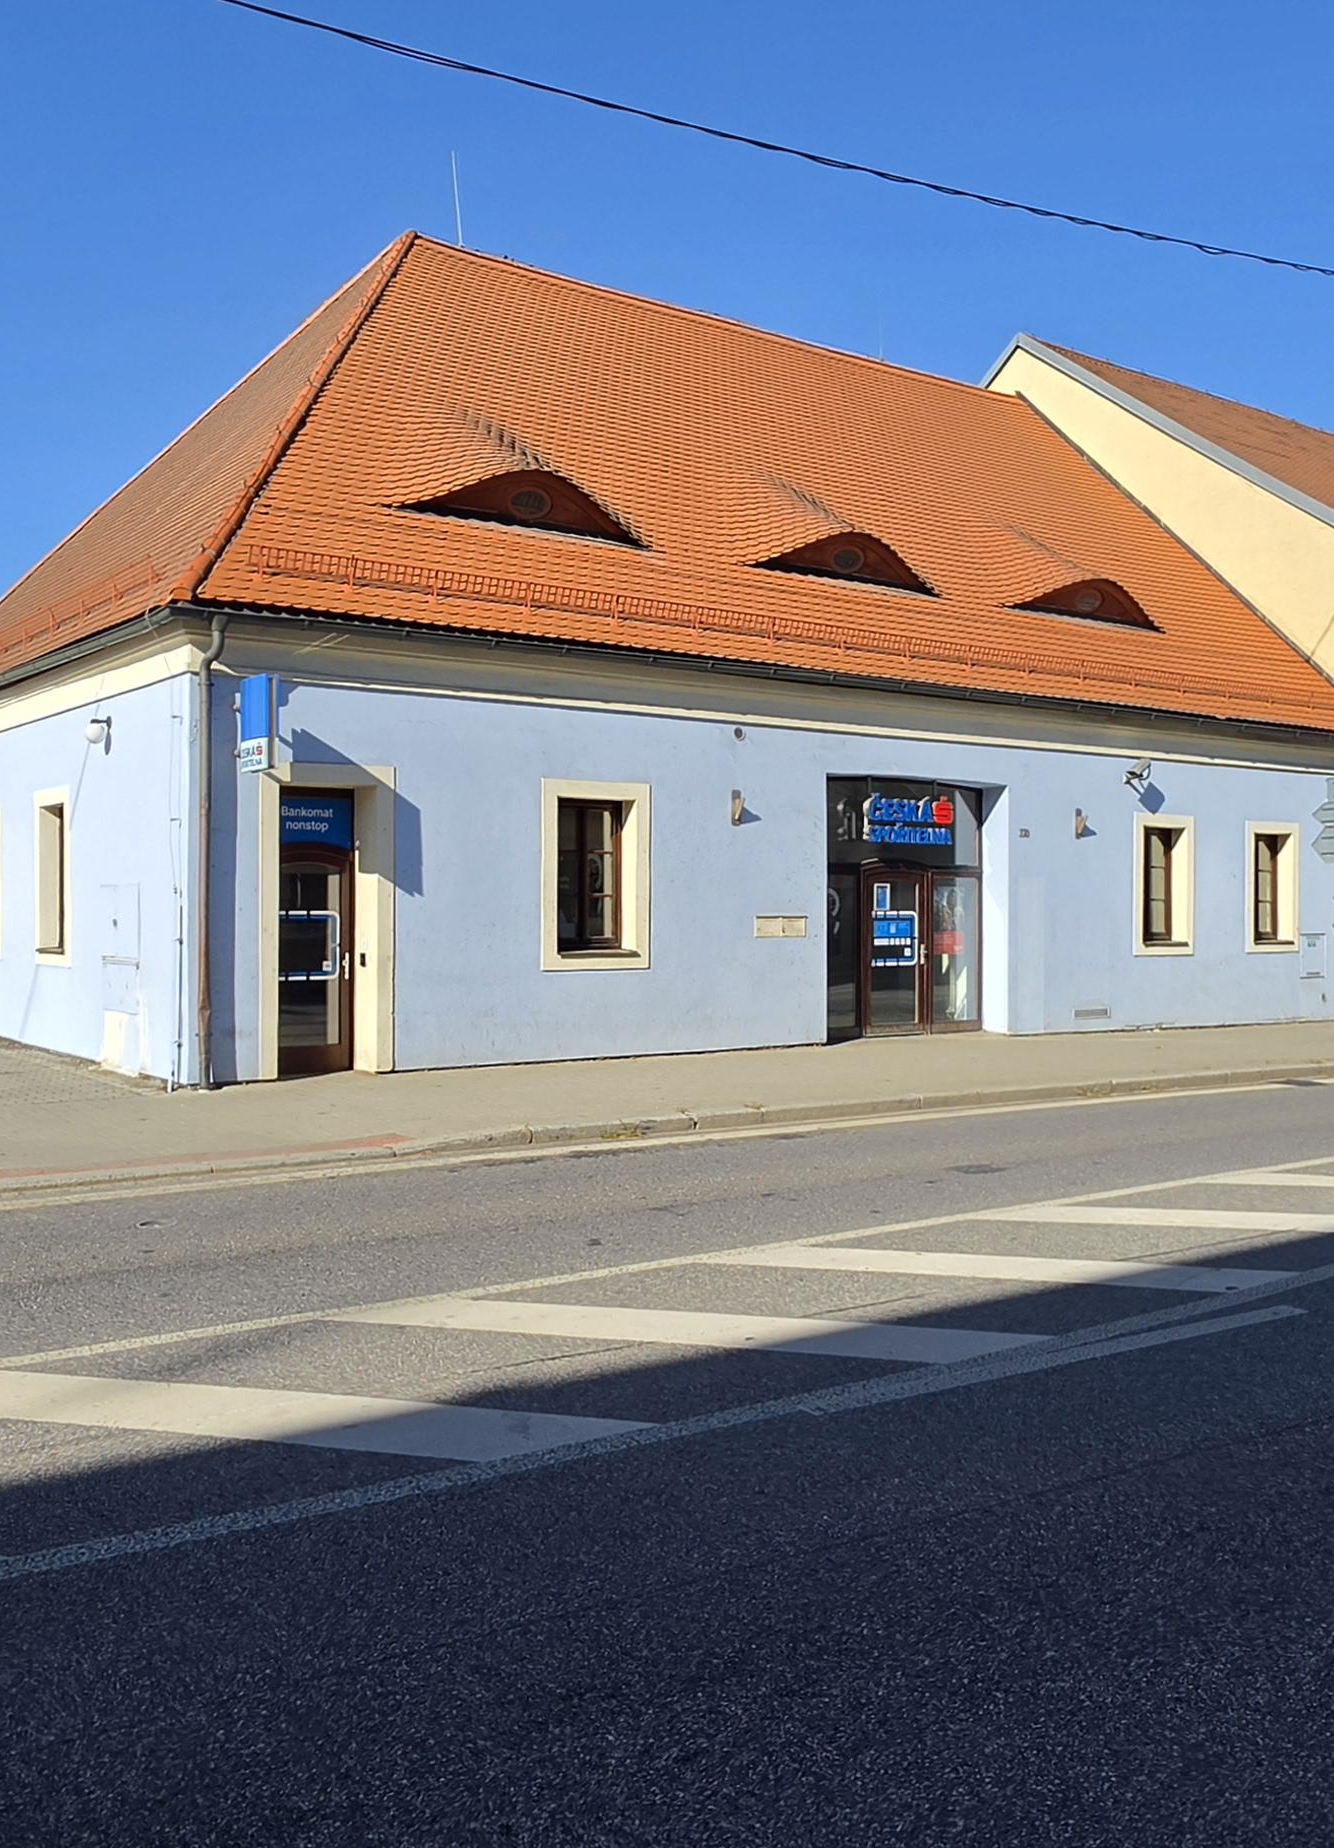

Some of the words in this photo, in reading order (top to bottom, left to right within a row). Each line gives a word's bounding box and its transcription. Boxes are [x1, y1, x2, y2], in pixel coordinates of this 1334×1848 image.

[281, 805, 334, 818] Bankomat
[863, 793, 934, 822] ČESKÁ
[285, 820, 329, 833] nonstop
